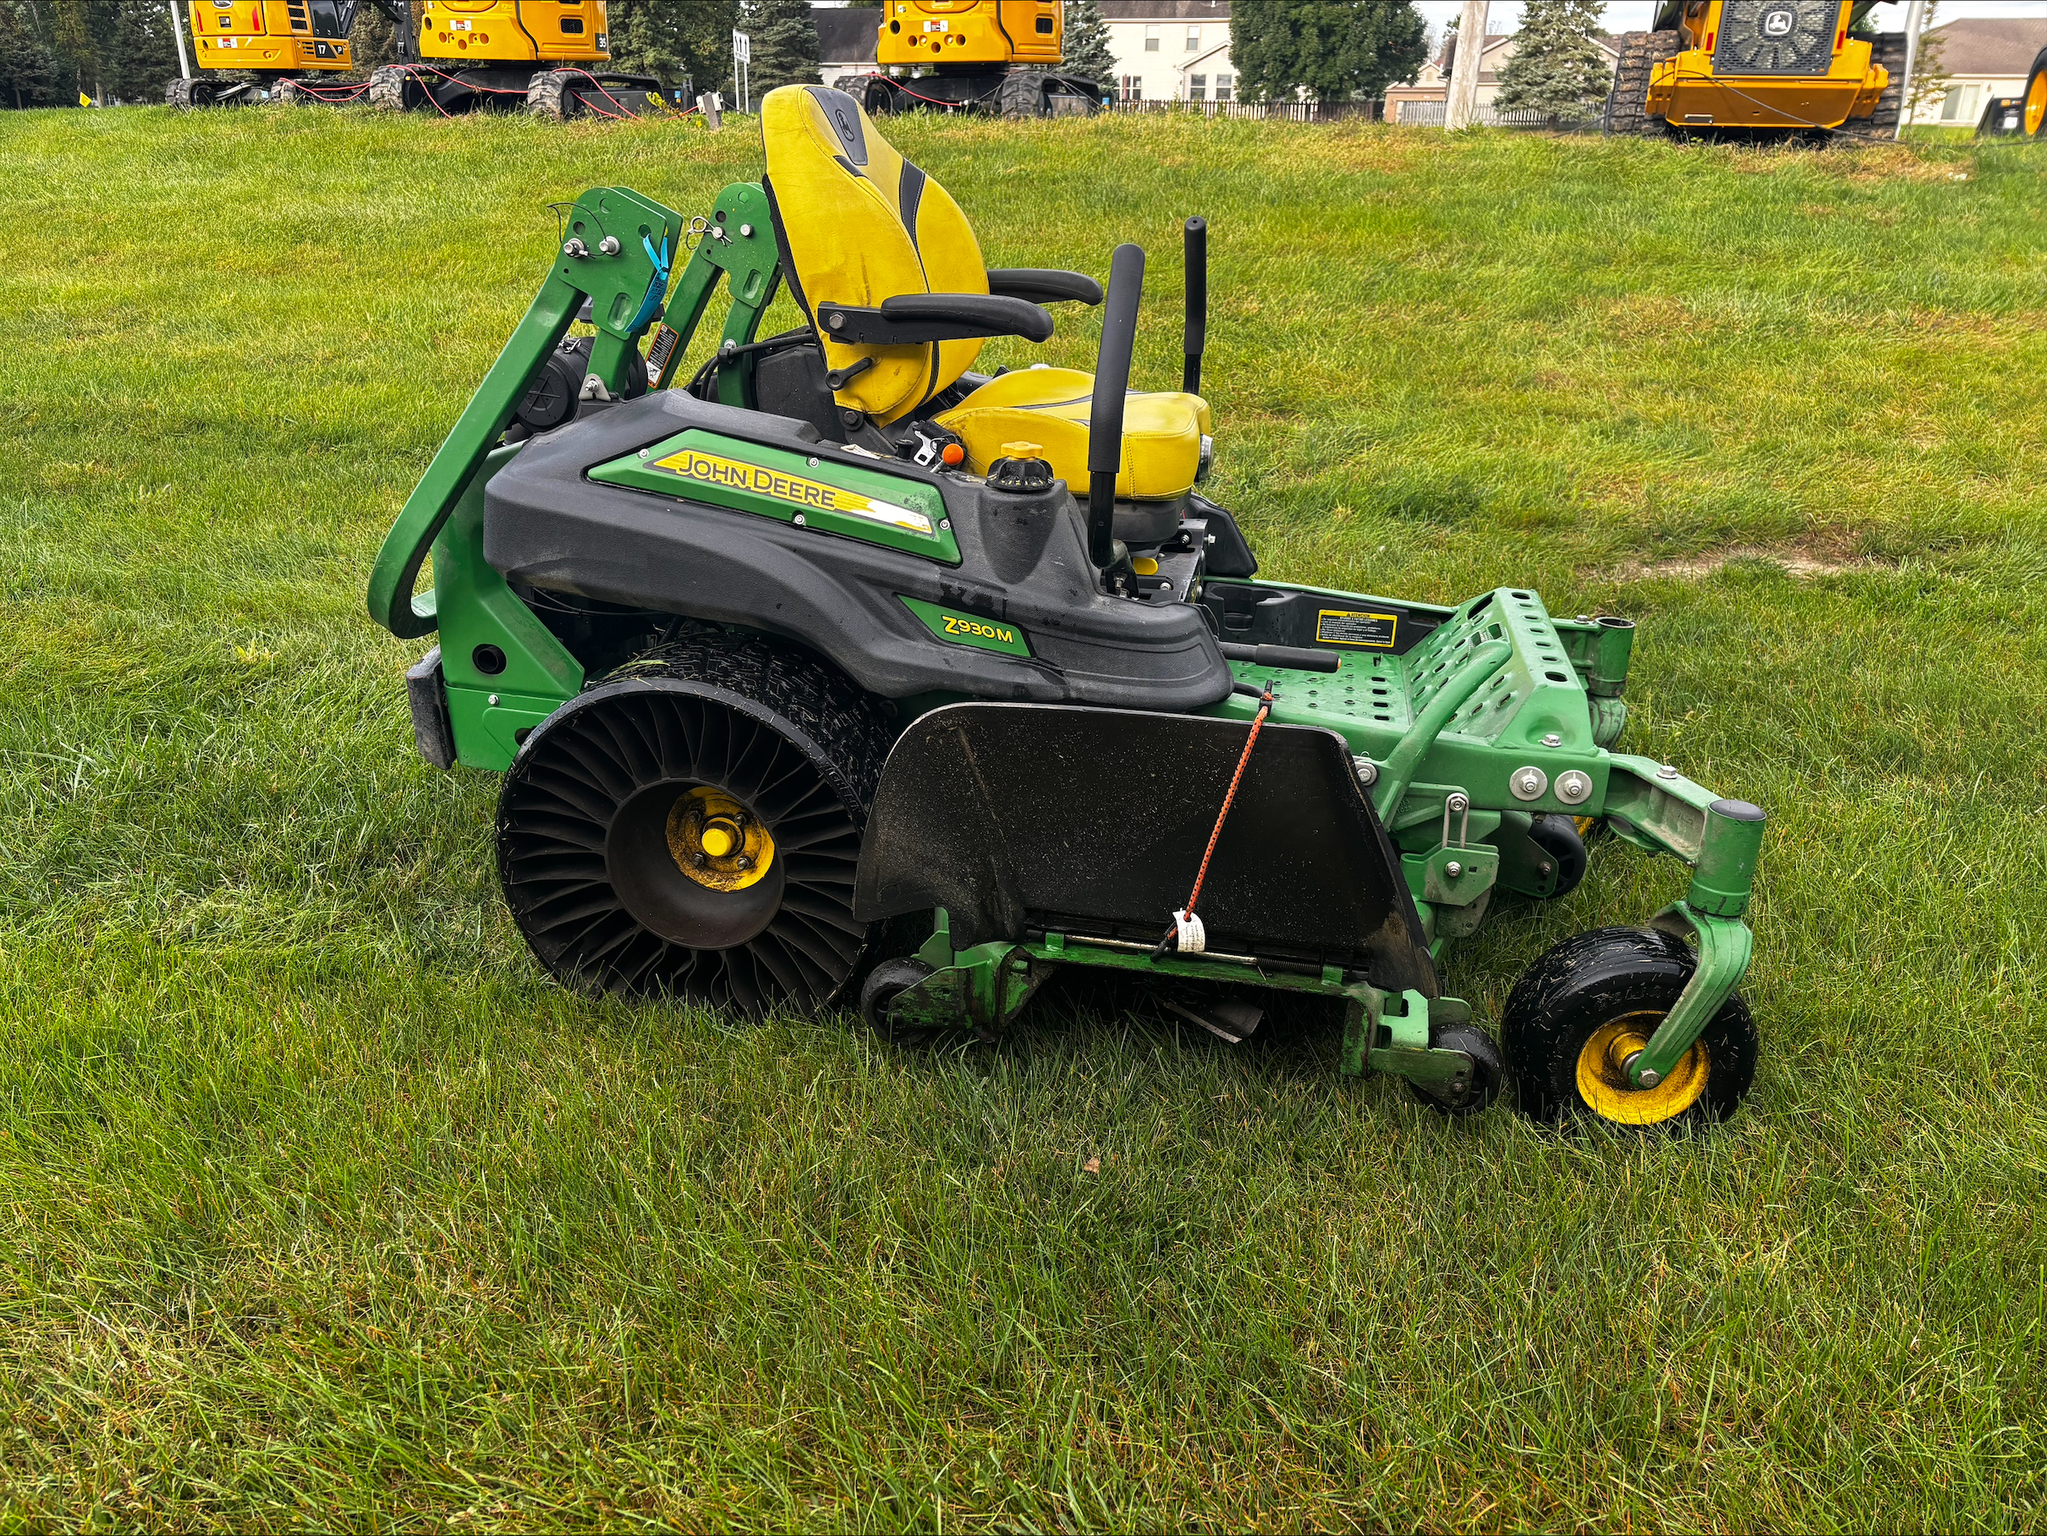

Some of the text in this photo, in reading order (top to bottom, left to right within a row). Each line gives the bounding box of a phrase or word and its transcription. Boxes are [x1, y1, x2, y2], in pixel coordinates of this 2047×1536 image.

[317, 44, 326, 55] 17
[679, 454, 836, 508] JOHN DEERE
